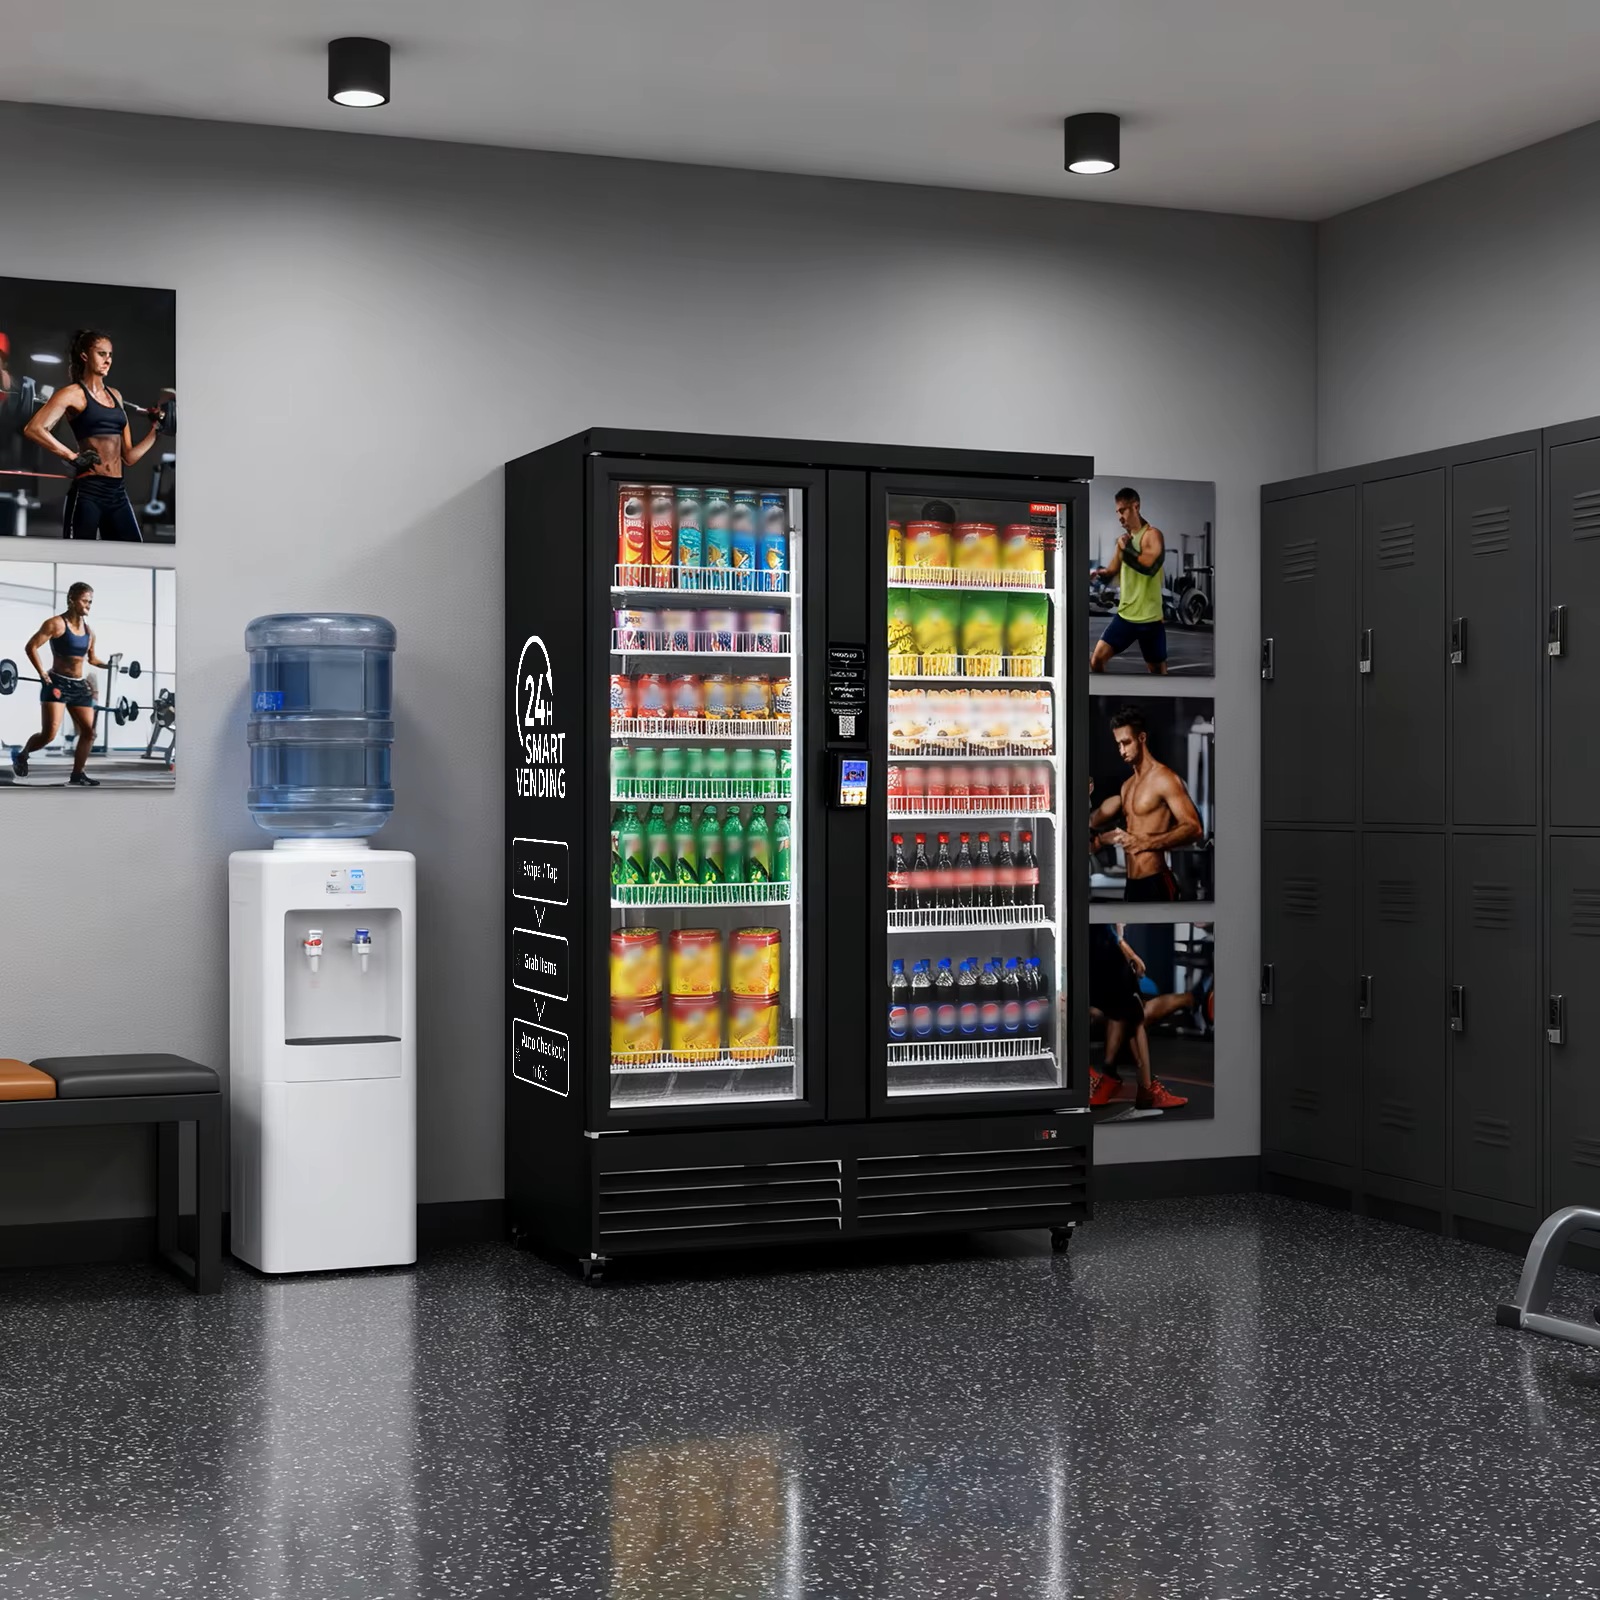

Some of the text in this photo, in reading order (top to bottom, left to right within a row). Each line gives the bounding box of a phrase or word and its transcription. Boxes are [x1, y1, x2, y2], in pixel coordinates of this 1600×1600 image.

[524, 673, 553, 727] 24H
[525, 732, 566, 765] SMART
[516, 767, 566, 799] VENDING
[524, 860, 542, 881] Swipe
[547, 864, 558, 884] Tap
[524, 953, 557, 976] Grab Items
